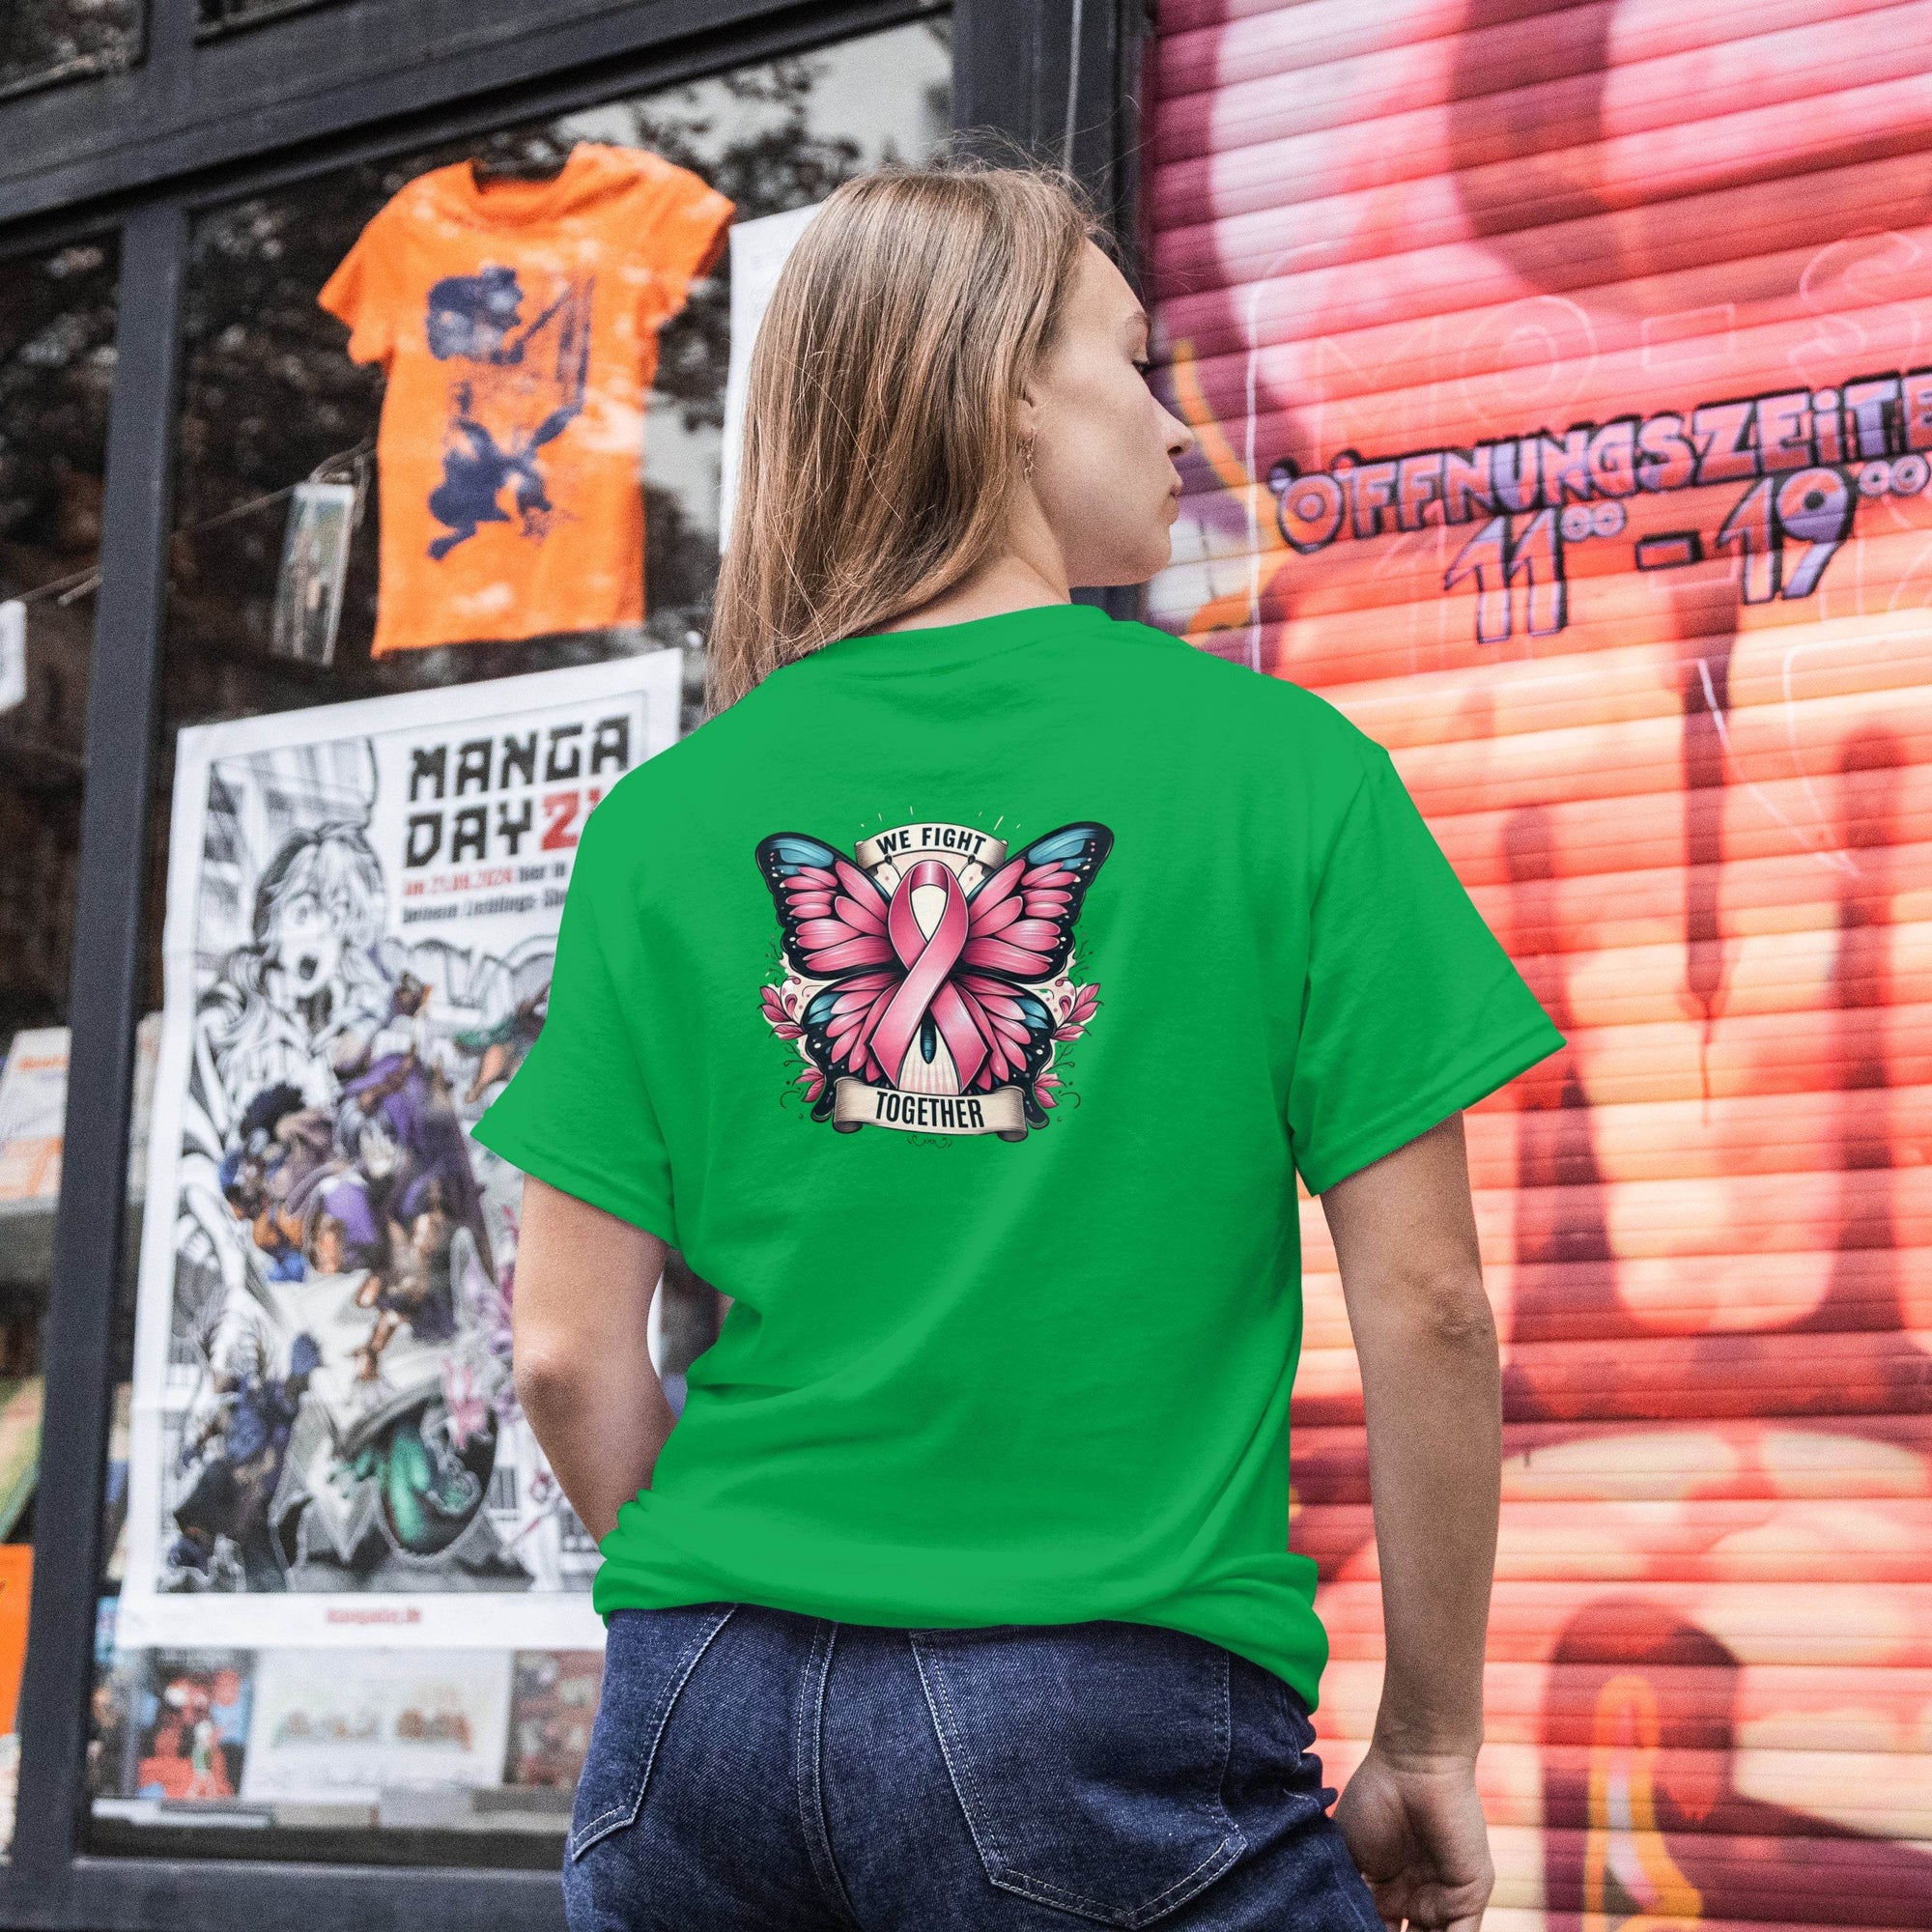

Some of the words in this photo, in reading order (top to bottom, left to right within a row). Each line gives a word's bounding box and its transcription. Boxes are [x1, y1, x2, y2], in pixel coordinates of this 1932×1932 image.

[410, 715, 631, 803] MANGA
[875, 829, 912, 856] WE
[922, 826, 988, 856] FIGHT
[874, 1090, 985, 1129] TOGETHER
